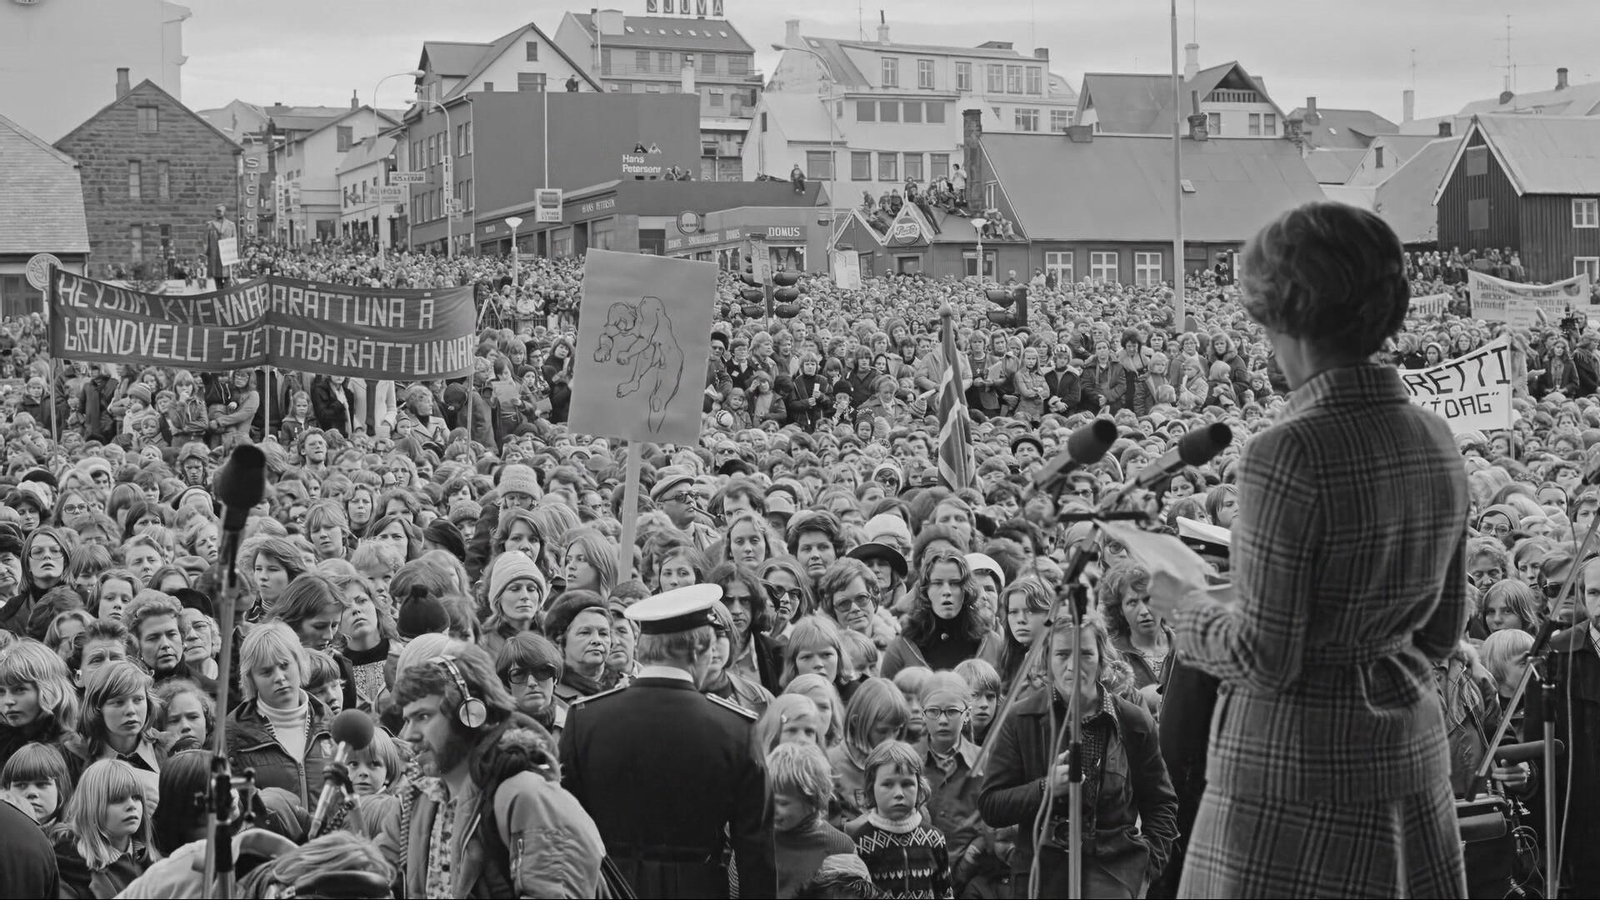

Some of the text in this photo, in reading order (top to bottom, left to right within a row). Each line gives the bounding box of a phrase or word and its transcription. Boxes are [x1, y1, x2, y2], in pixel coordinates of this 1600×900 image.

[622, 154, 645, 164] Hans
[245, 157, 259, 234] STELLA
[768, 227, 800, 237] DOMUS
